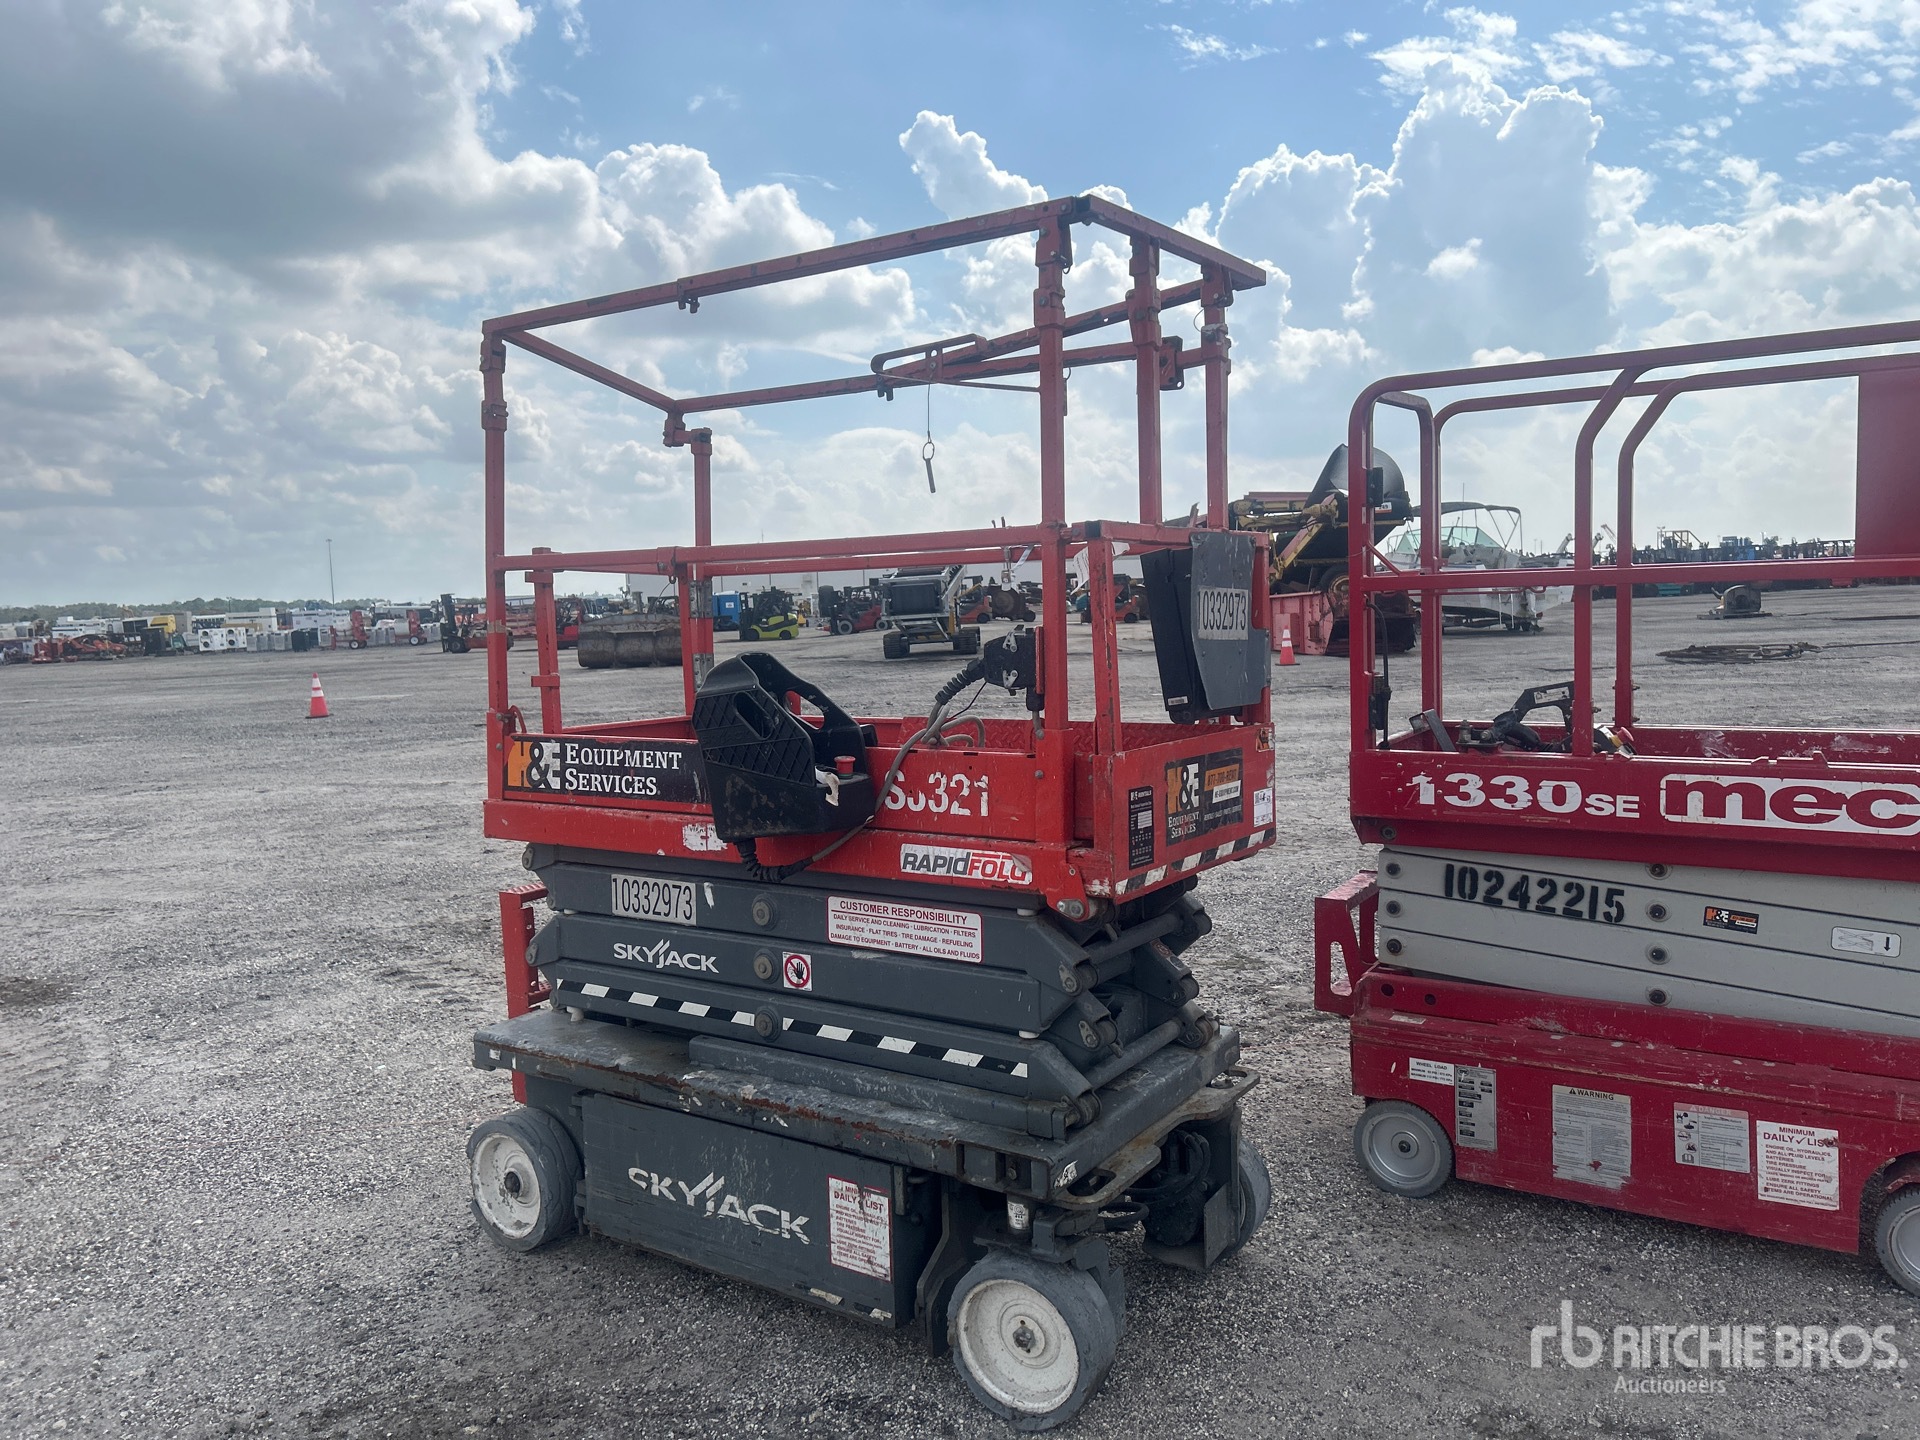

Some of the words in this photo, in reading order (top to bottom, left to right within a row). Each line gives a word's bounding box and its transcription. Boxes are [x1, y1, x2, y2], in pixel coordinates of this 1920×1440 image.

[1198, 590, 1246, 630] 10332973
[508, 740, 560, 790] H&E
[565, 743, 682, 770] EQUIPMENT
[566, 768, 657, 796] SERVICES
[1666, 780, 1920, 829] mec
[612, 878, 692, 920] 10332973
[1444, 864, 1625, 924] 10242215
[840, 900, 890, 914] CUSTOMER
[892, 908, 968, 924] RESPONSIBILITY
[836, 924, 865, 933] INSURANCE
[914, 934, 938, 943] DAMAGE
[941, 938, 973, 948] REFUELING
[848, 916, 870, 924] SERVICE
[883, 920, 910, 929] CLEANING
[914, 924, 950, 934] LUBRICATION
[953, 930, 976, 938] FILTERS
[830, 933, 852, 941] DAMAGE
[861, 937, 891, 946] EQUIPMENT
[894, 942, 918, 950] BATTERY
[613, 938, 720, 974] SKYJACK
[1576, 1089, 1614, 1100] WARNING
[1764, 1132, 1794, 1144] DAILY
[1779, 1127, 1815, 1136] MINIMUM
[628, 1167, 810, 1244] SKYJACK
[834, 1191, 857, 1204] DAILY
[866, 1200, 884, 1213] LIST
